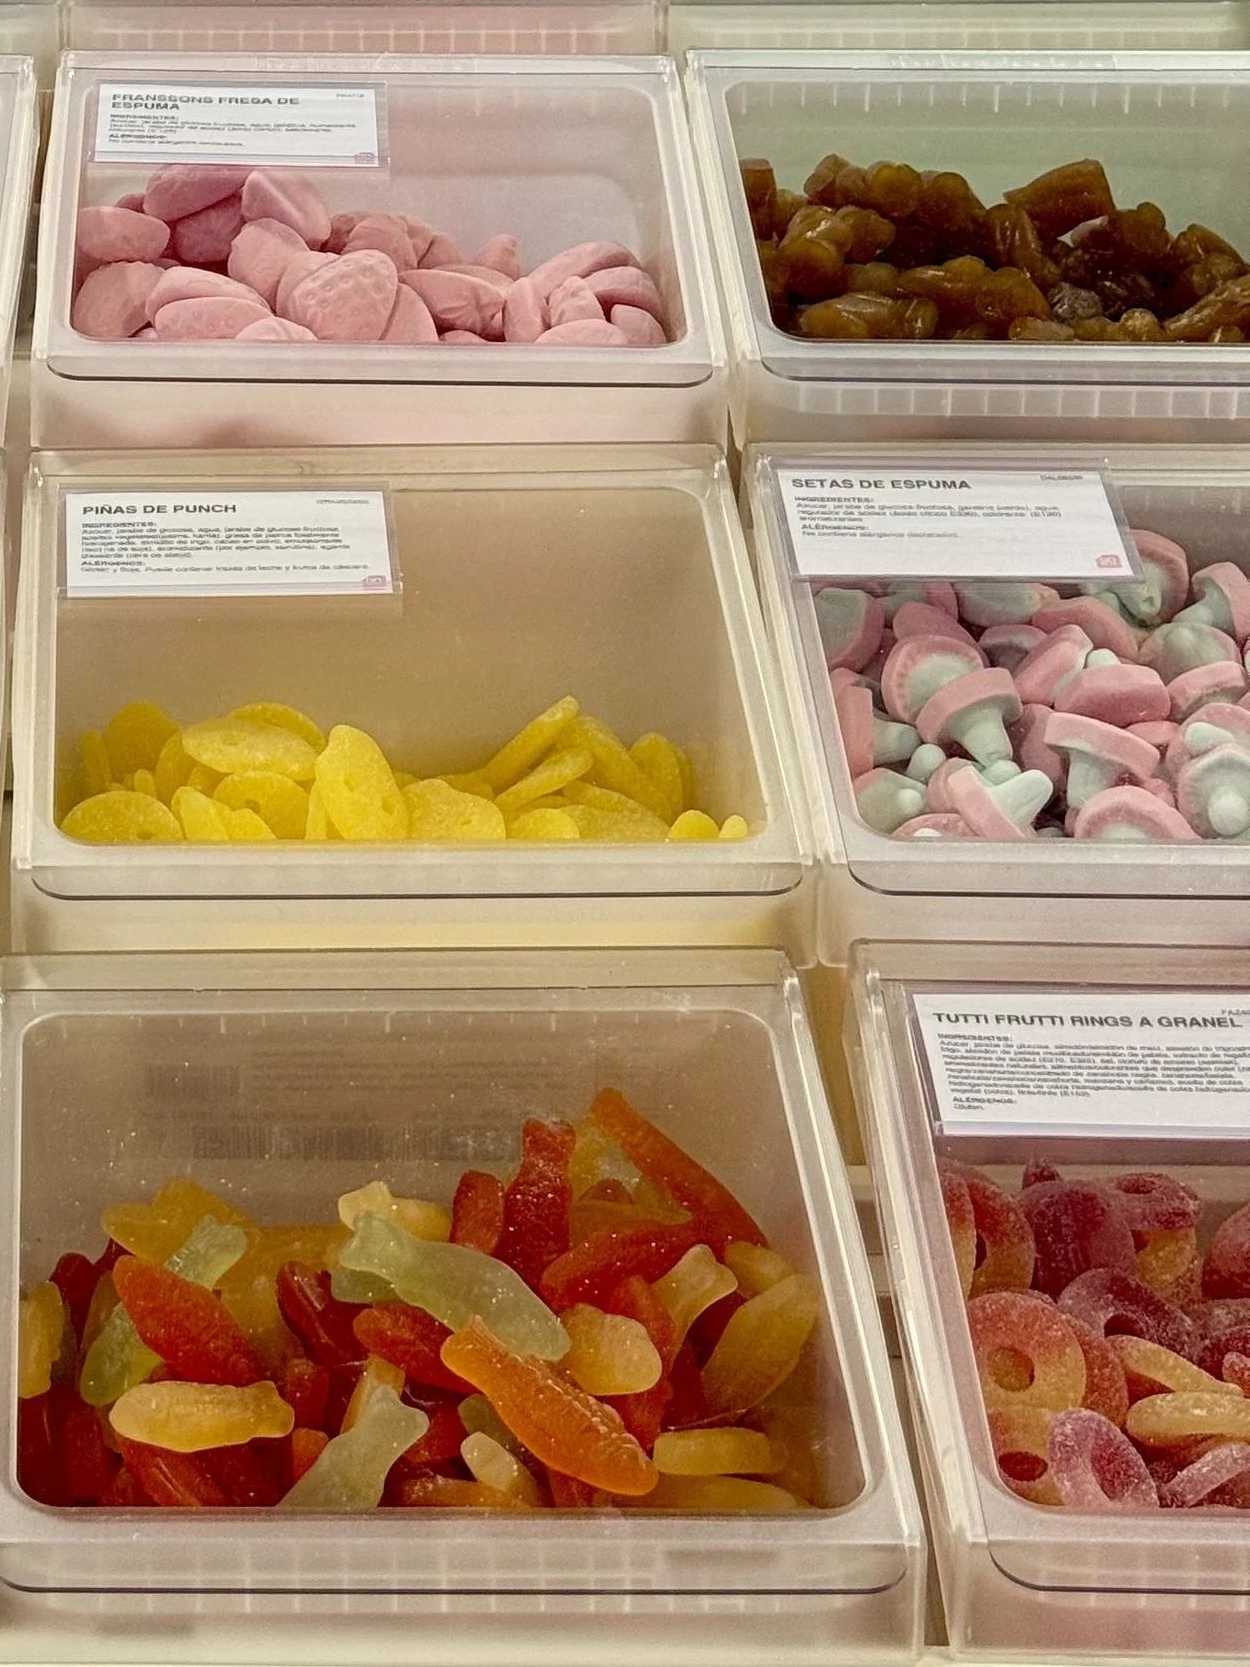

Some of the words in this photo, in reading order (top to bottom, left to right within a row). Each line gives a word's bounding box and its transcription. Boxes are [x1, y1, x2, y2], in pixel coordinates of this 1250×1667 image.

[112, 94, 213, 104] FRANSSONS
[218, 96, 272, 105] FRESA
[277, 97, 300, 105] DE
[111, 102, 179, 110] ESPUMA
[791, 478, 854, 488] SETAS
[859, 480, 885, 489] DE
[891, 479, 972, 489] ESPUMA
[82, 504, 138, 515] PIÑAS
[143, 505, 168, 514] DE
[173, 504, 237, 513] PUNCH
[932, 1012, 989, 1024] TUTTI
[994, 1014, 1065, 1026] FRUTTI
[1070, 1015, 1133, 1027] RINGS
[1139, 1016, 1153, 1027] A
[1157, 1016, 1244, 1028] GRANEL
